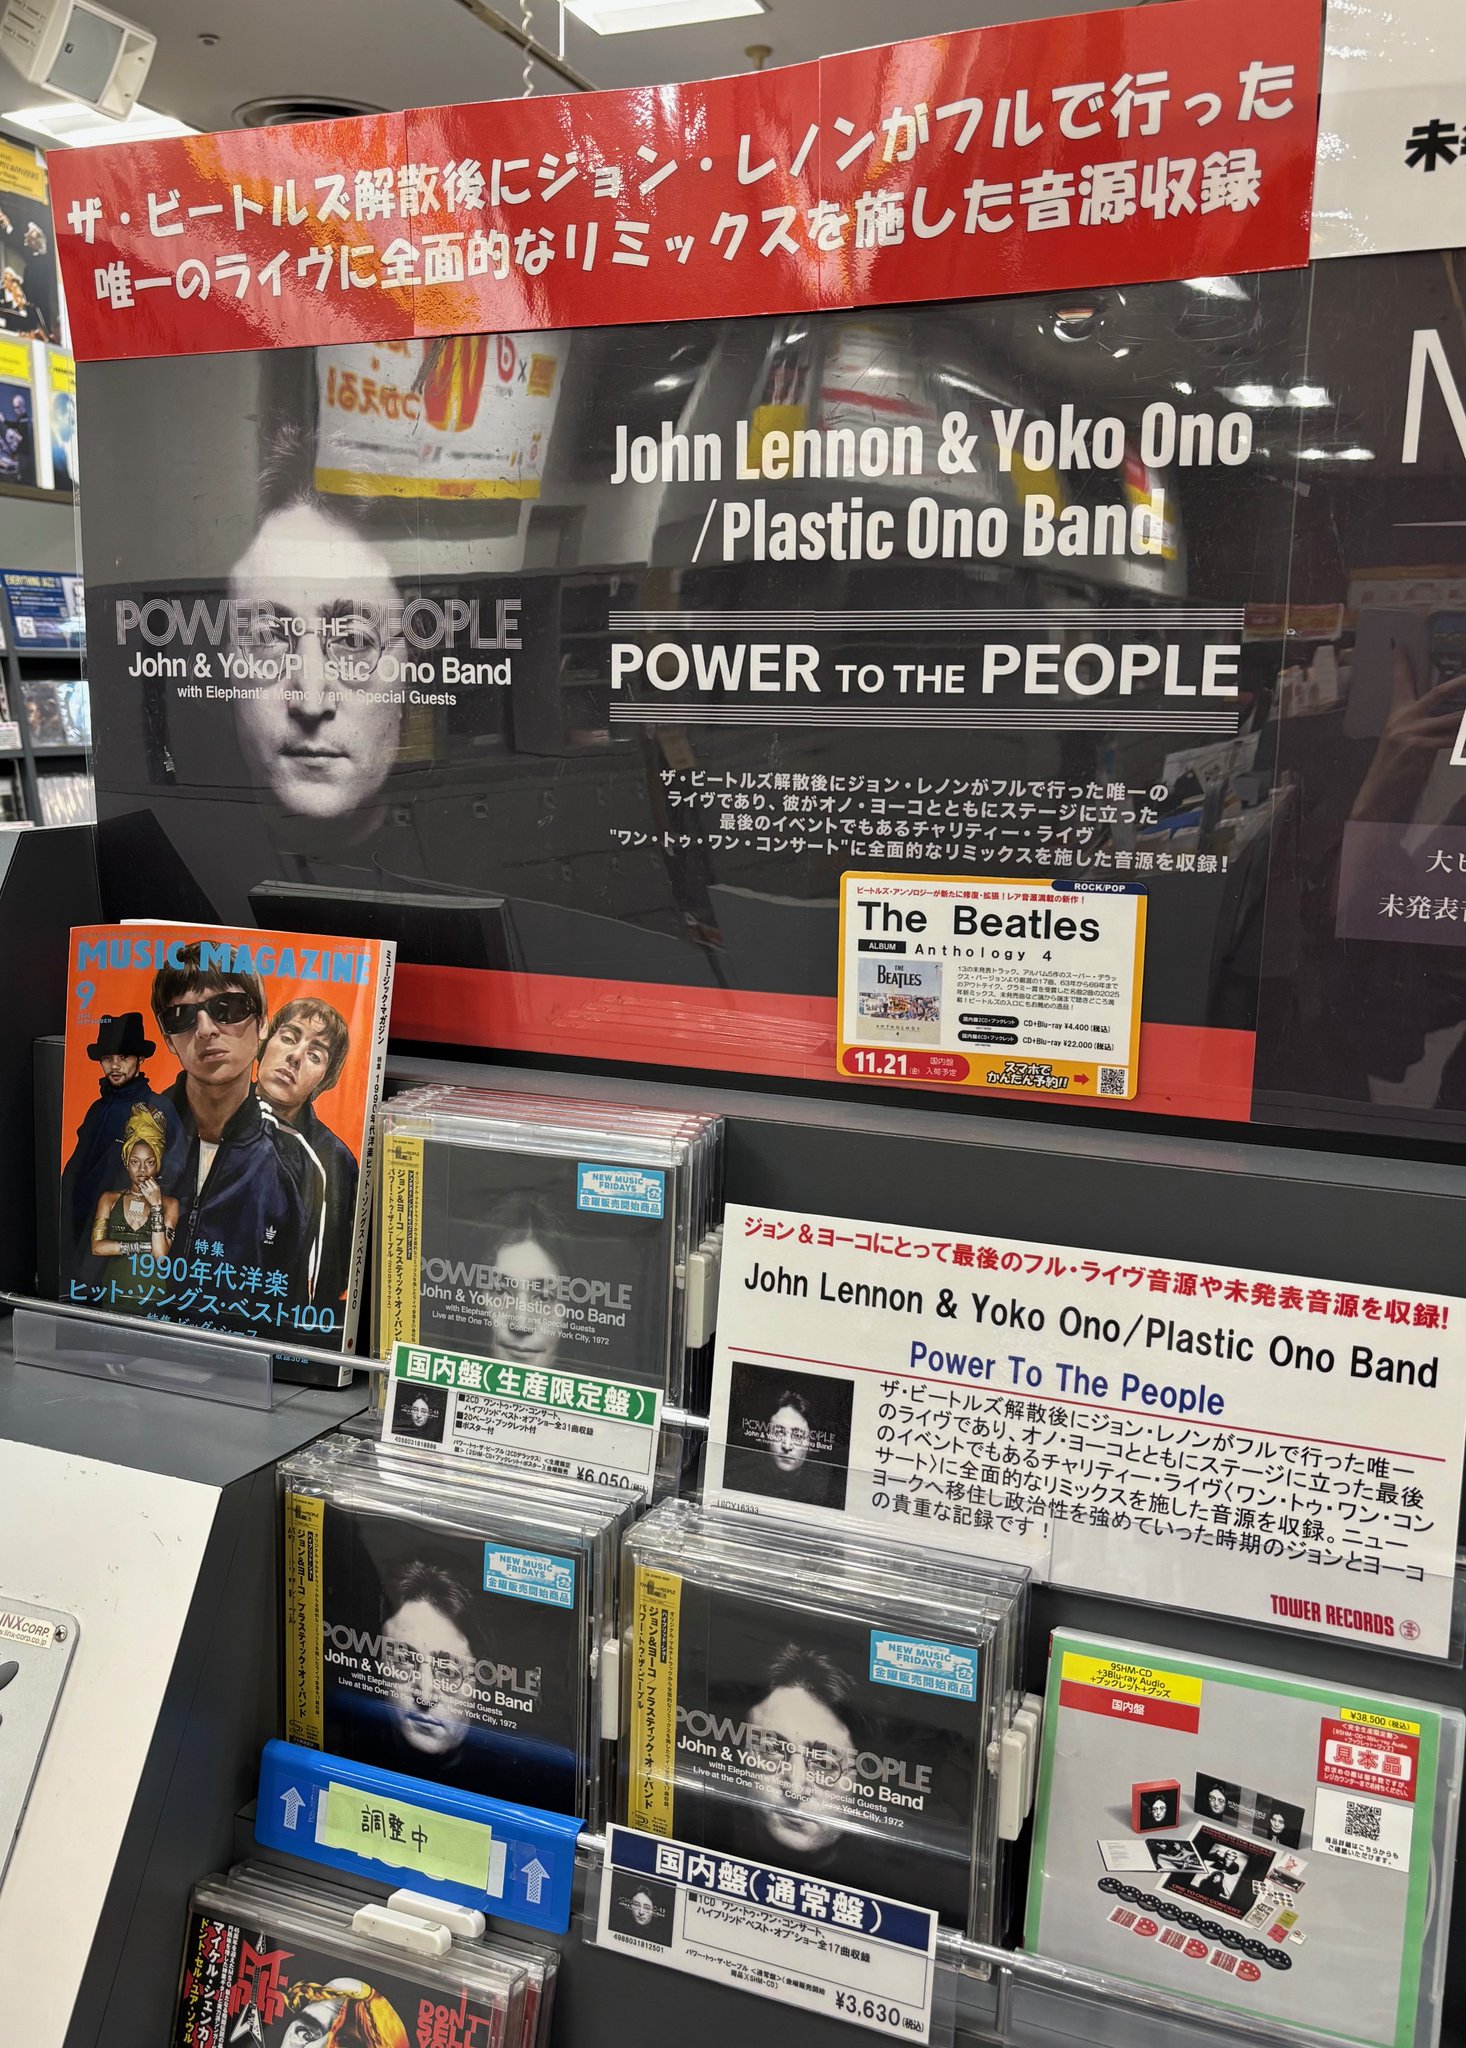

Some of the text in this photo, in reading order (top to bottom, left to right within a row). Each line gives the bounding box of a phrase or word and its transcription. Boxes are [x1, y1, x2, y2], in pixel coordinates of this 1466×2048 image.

[67, 60, 1296, 245] ザ・ビートルズ解散後にジョン・レノンがフルで行った
[1405, 118, 1466, 173] 未
[94, 148, 1262, 310] 唯一のライヴに全面的なリミックスを施した音源収録
[610, 402, 1252, 484] John Lennon & Yoko Ono
[692, 488, 1164, 563] /Plastic Ono Band
[116, 599, 522, 650] POWER TO THE PEOPLE
[128, 652, 511, 685] John & Ono Band
[610, 644, 1241, 695] POWER TO THE PEOPLE
[177, 686, 457, 706] with Elephant's Special Guests
[659, 768, 1168, 803] ザ・ビートルズ解散後にジョン・レノンがフルで行った唯一の
[668, 791, 1158, 825] ライヴであり、彼がオノ・ヨーコとともにステージに立った
[720, 812, 1094, 845] 最後のイベントでもあるチャリティー・ライヴ
[1074, 882, 1125, 892] ROCK/POP
[858, 901, 1100, 942] The Beatles
[77, 939, 372, 985] MUSIC MAGAZINE
[868, 941, 1052, 962] ALBUM Anthology 4
[877, 965, 921, 988] BEATLES
[75, 979, 96, 1010] 9
[377, 949, 392, 1045] ミュージック・マガジン
[1023, 1020, 1062, 1029] CD+Blu-ray
[1023, 1037, 1061, 1047] CD+Blu-ray
[854, 1051, 908, 1076] 11.21
[925, 1067, 957, 1077] 入荷予定
[930, 1057, 954, 1066] 国内盤
[1004, 1062, 1052, 1077] スマホで
[986, 1071, 1069, 1089] かんたん予約!!
[592, 1173, 643, 1185] NEW MUSIC
[599, 1182, 637, 1192] FRIDAYS
[195, 1239, 225, 1257] 特集
[127, 1253, 289, 1298] 1990年代洋楽
[744, 1216, 1449, 1330] ジョン＆ヨーコにとって最後のフル・ライヴ音源や未発表音源を収録！
[69, 1279, 335, 1334] ヒット・ソングス・ベスト100
[420, 1283, 625, 1327] John & Ono Band
[504, 1272, 633, 1310] TO THE PEOPLE
[592, 1336, 609, 1345] 1972
[744, 1262, 1439, 1388] John Lennon & Yoko Ono/Plastic Ono Band
[406, 1350, 645, 1420] 国内盤(生産限定盤)
[911, 1340, 1225, 1416] Power To The People
[465, 1395, 480, 1405] 2CD
[462, 1421, 495, 1435] ポスター付
[880, 1379, 1416, 1480] ザ・ビートルズ解散後にジョン・レノンがフルで行った唯一
[877, 1402, 1425, 1510] のライヴであり、オノ・ヨーコとともにステージに立った最後
[872, 1491, 1049, 1539] の貴重な記録です！
[872, 1468, 1425, 1582] ヨークへ移住し政治性を強めていった時期のジョンとヨーコ
[500, 1555, 552, 1572] NEW MUSIC
[506, 1564, 545, 1578] FRIDAYS
[1270, 1594, 1321, 1623] TOWER
[1326, 1604, 1394, 1637] RECORDS
[888, 1643, 951, 1662] NEW MUSIC
[896, 1653, 943, 1669] FRIDAYS
[324, 1648, 533, 1712] John & Ono Band
[409, 1651, 541, 1696] TO THE PEOPLE
[875, 1667, 971, 1695] 金曜販売開始商品
[1097, 1669, 1165, 1688] +3Blu-ray Audio
[1110, 1662, 1153, 1678] 9SHM-CD
[1091, 1676, 1171, 1698] +ブックレット+グッズ
[500, 1719, 517, 1729] 1972
[1112, 1699, 1145, 1716] 国内盤
[1350, 1711, 1410, 1730] ¥38,500 (税込)
[677, 1735, 924, 1810] John & Ono Band
[778, 1741, 932, 1794] TO THE PEOPLE
[1333, 1744, 1401, 1776] 見本品
[360, 1804, 428, 1853] 調整中
[655, 1843, 882, 1934] 国内盤(通常盤)
[698, 1894, 716, 1908] 1CD
[613, 1933, 664, 1955] 4988031812501
[183, 1918, 209, 2044] ドント・セル・ユア・ソウル
[836, 1989, 925, 2033] ¥3,630 (税込)
